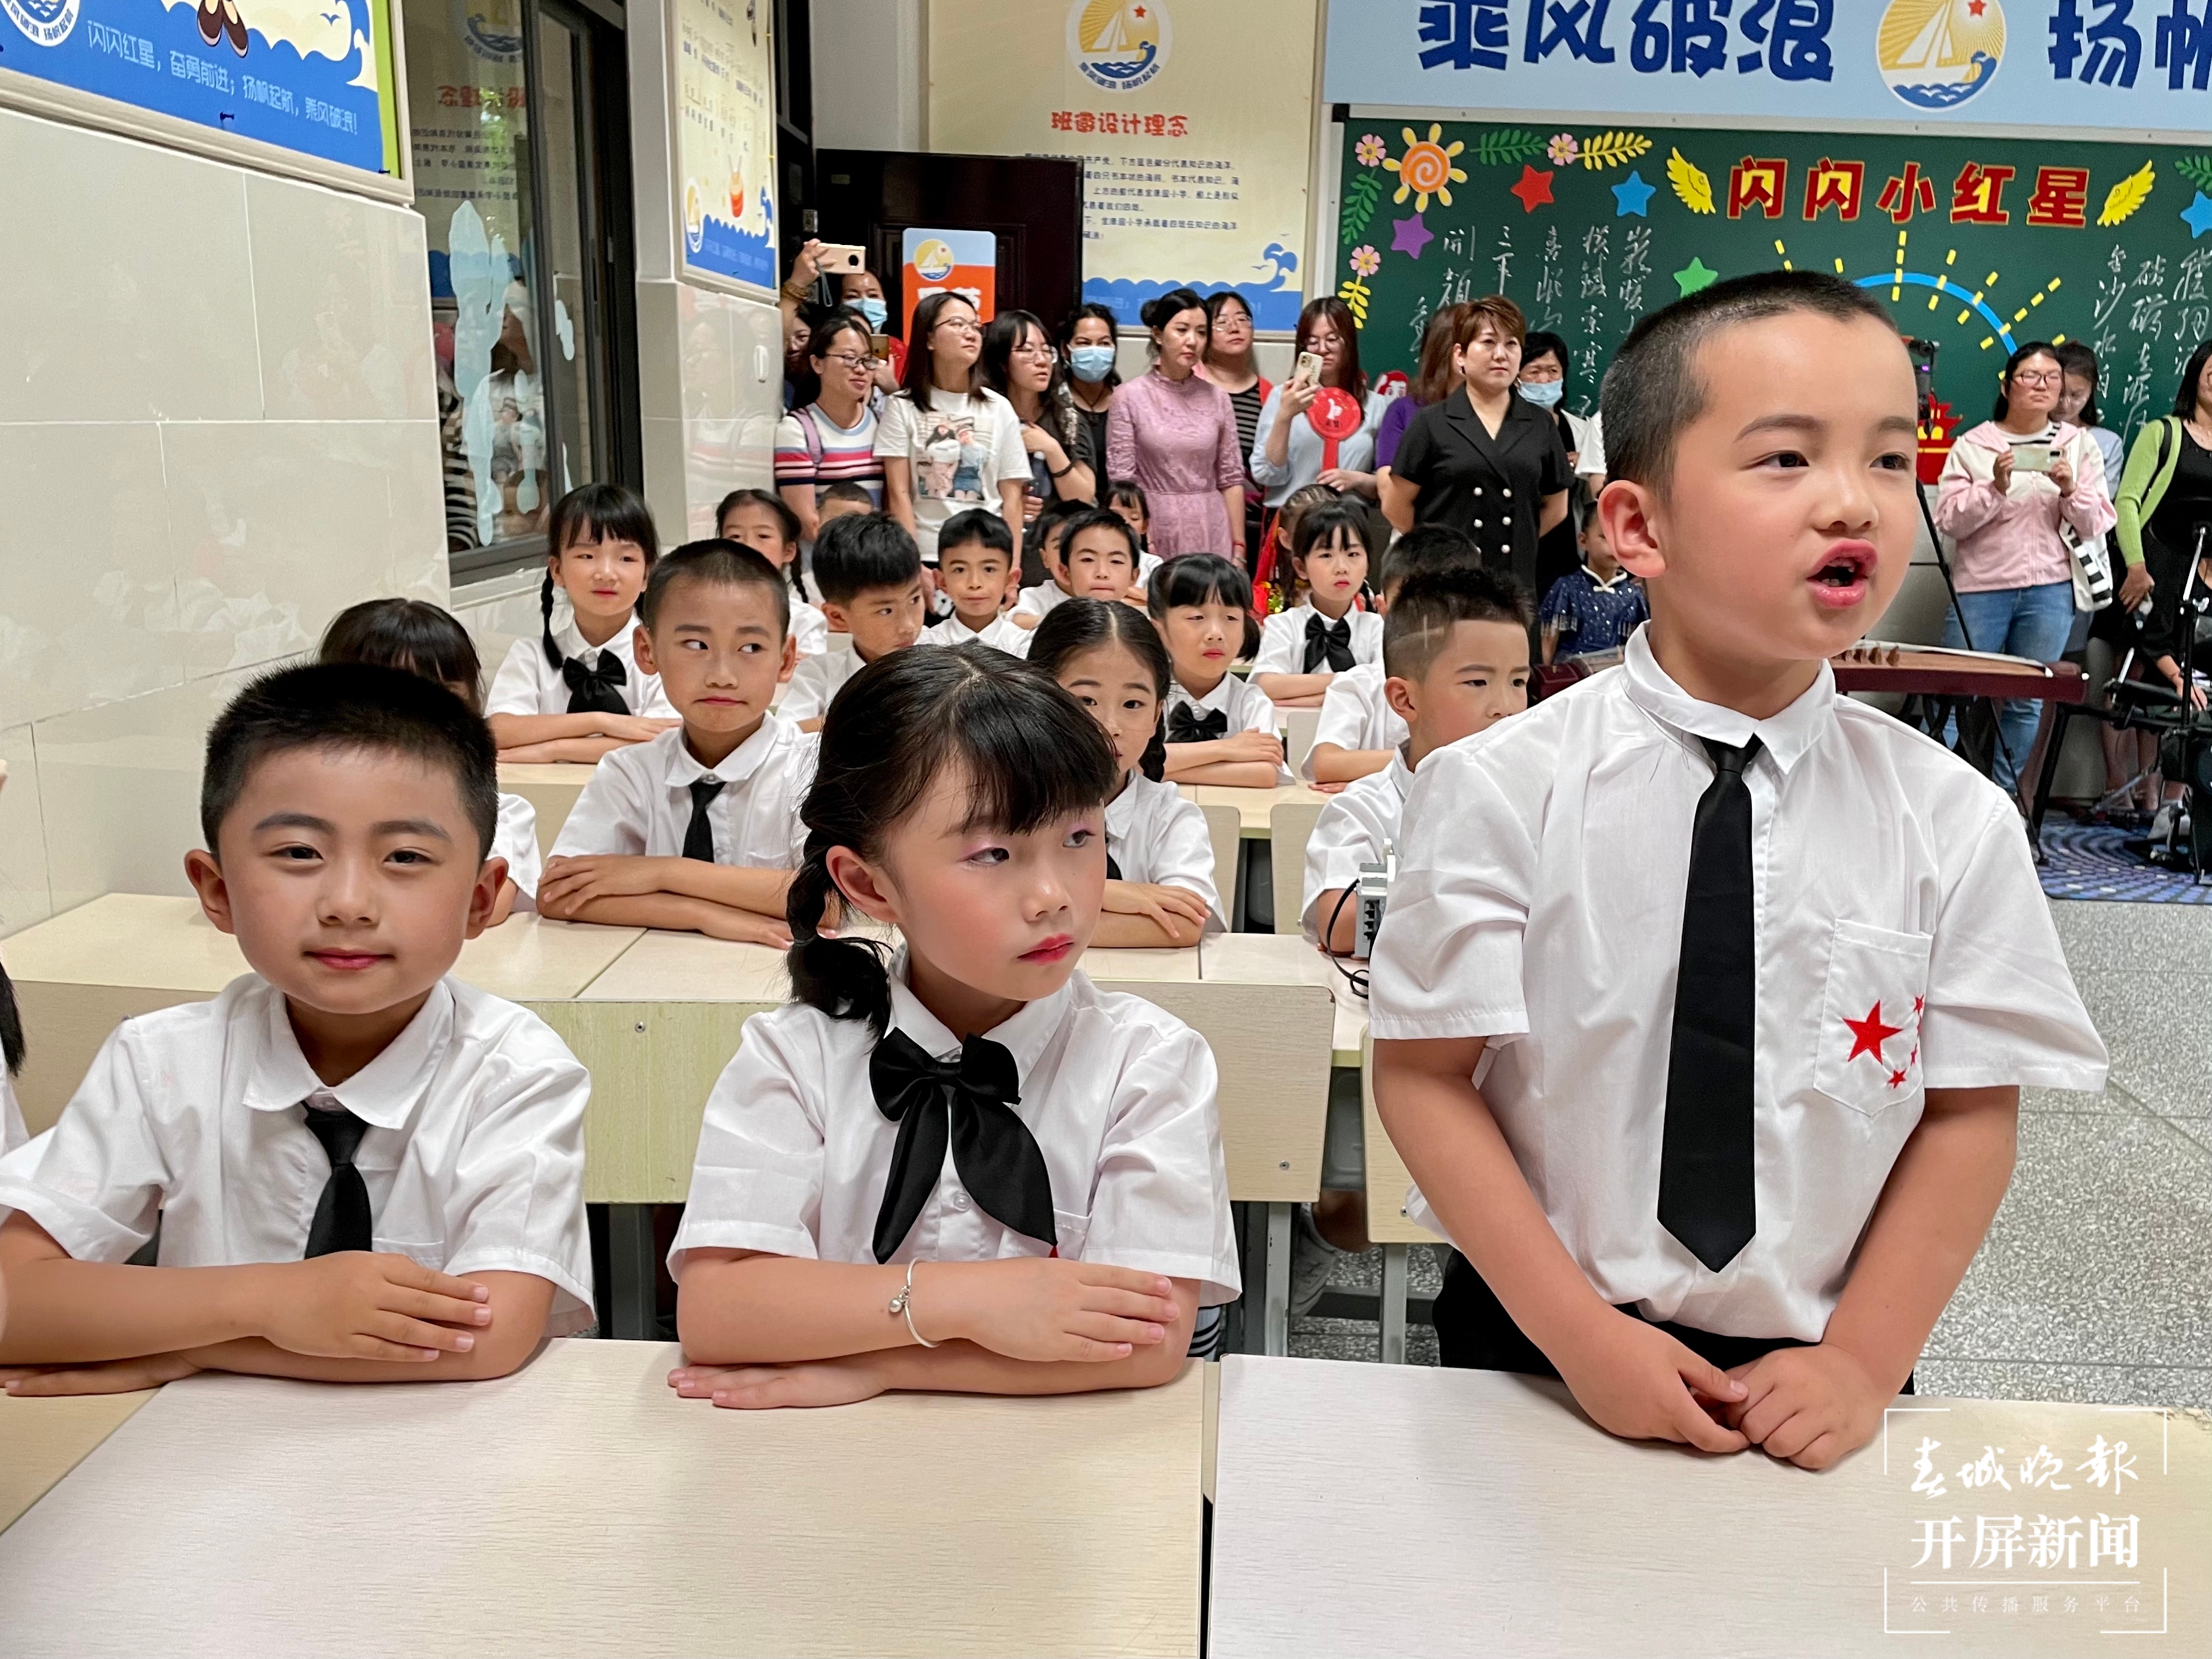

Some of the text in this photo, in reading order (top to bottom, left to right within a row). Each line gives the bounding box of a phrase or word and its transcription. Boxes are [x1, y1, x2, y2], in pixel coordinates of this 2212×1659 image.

[1418, 0, 1835, 81] 乘风破浪
[1727, 156, 2089, 228] 闪闪小红星
